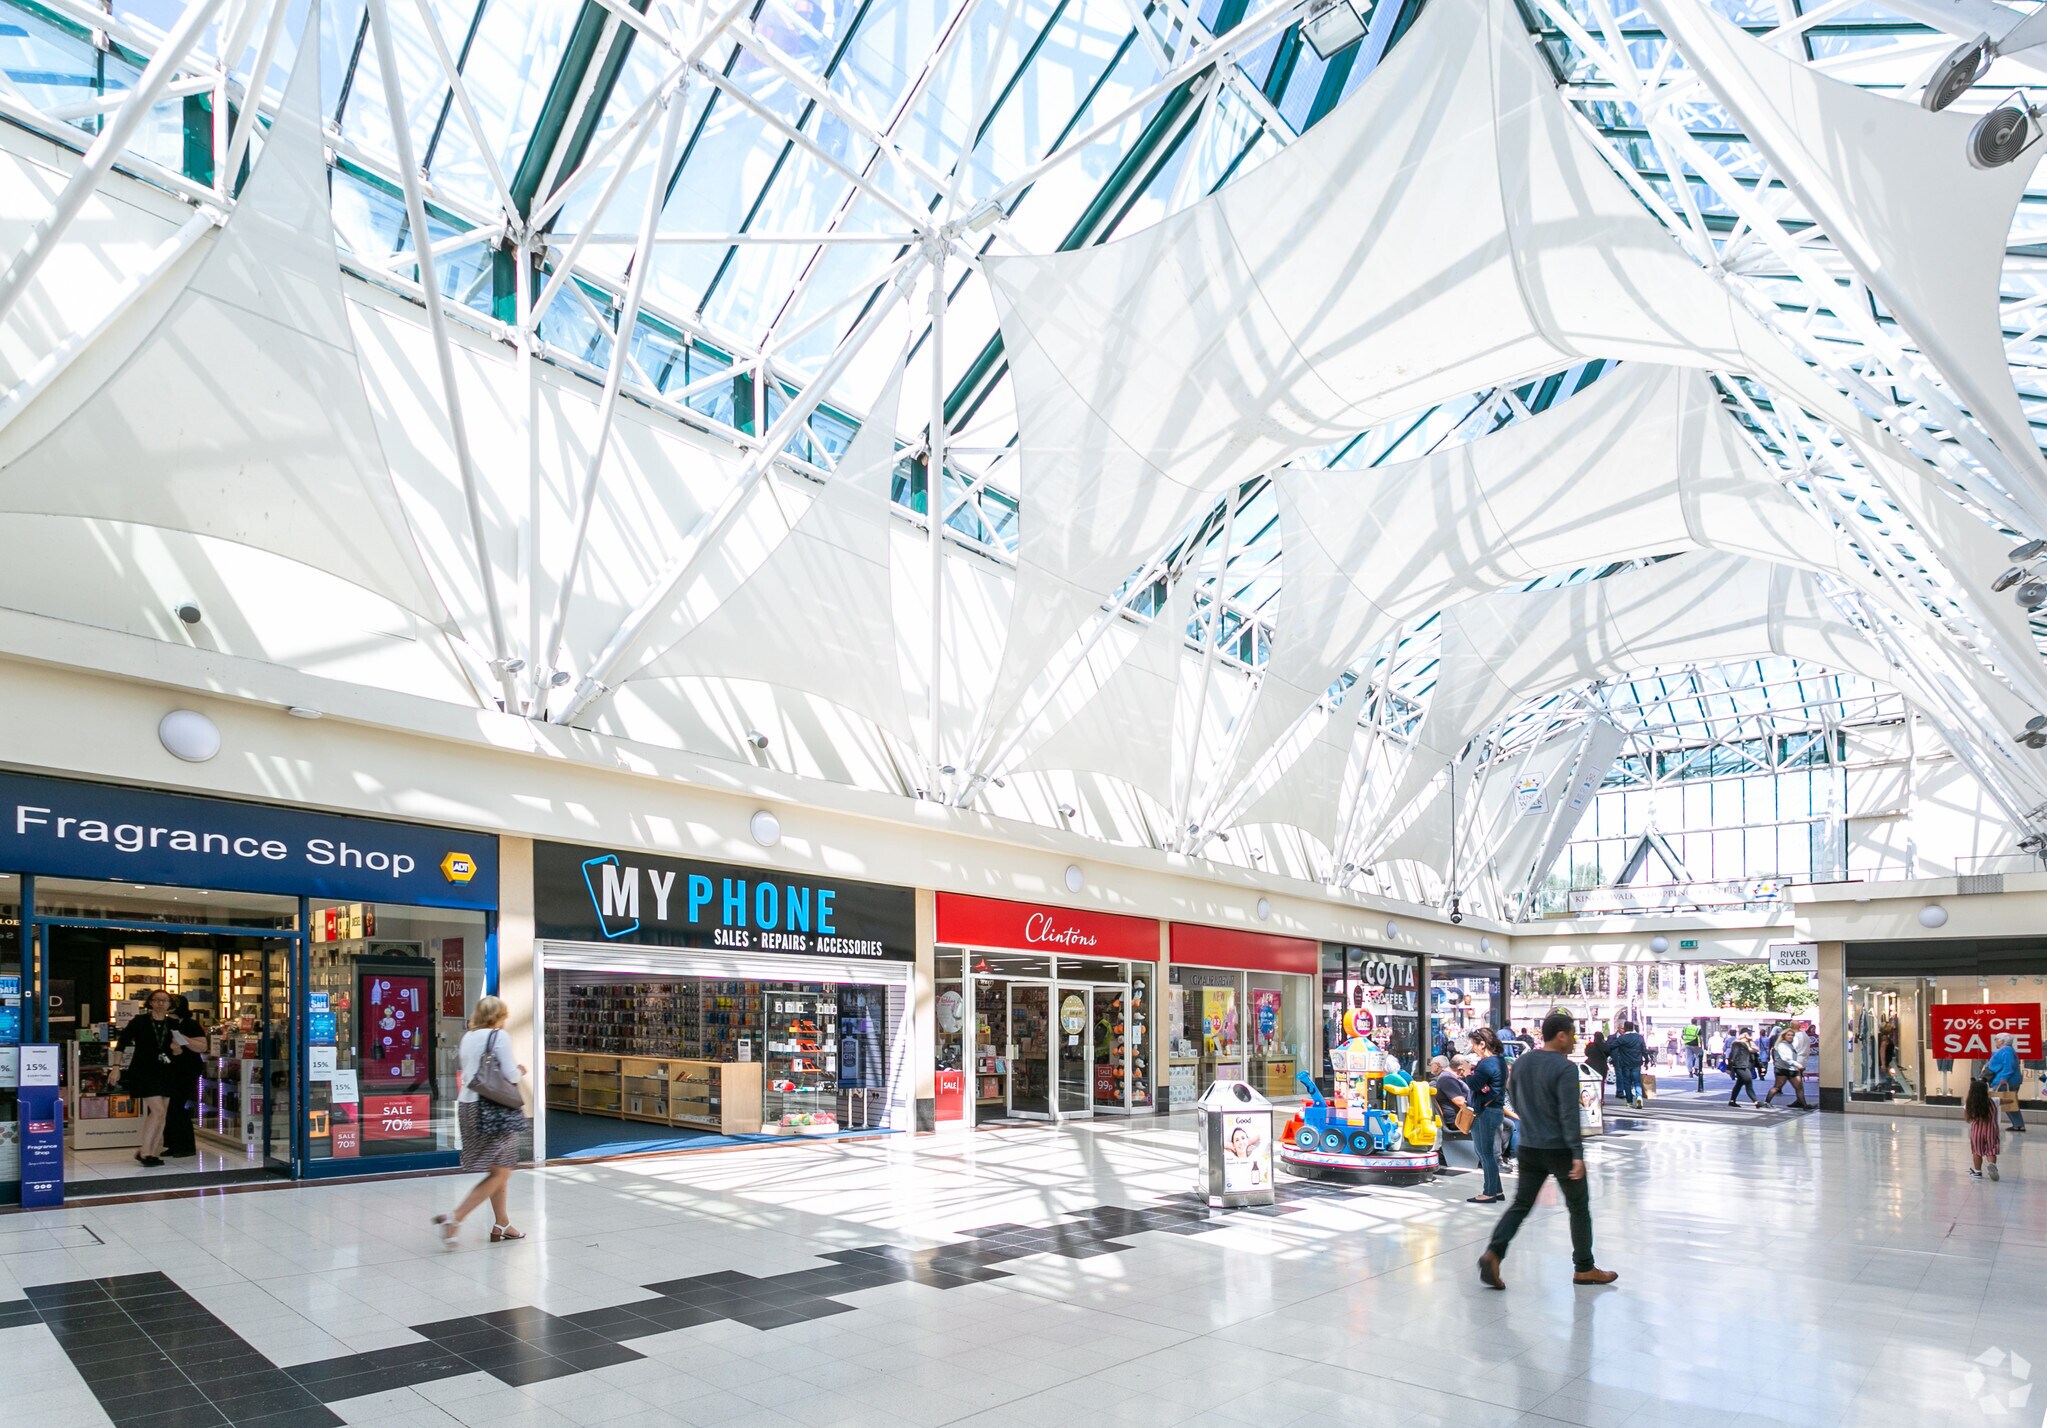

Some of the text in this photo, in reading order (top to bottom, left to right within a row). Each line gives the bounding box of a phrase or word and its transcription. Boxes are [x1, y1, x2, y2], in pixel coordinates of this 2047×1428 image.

[16, 804, 416, 878] Fragrance Shop
[452, 861, 469, 873] ADT
[602, 863, 836, 934] MY PHONE
[1025, 912, 1098, 946] Clintons
[714, 928, 883, 956] SALES REPAIRS ACCESSORIES
[1780, 950, 1807, 958] RIVER
[444, 960, 462, 973] SALE
[1778, 958, 1811, 966] ISLAND
[1366, 960, 1415, 989] COSTA
[1943, 1018, 2030, 1030] 70% OFF
[26, 1063, 48, 1071] 15%
[943, 1081, 957, 1090] SALE
[1098, 1080, 1113, 1091] 99p
[383, 1105, 413, 1115] SALE
[382, 1118, 413, 1132] 70%
